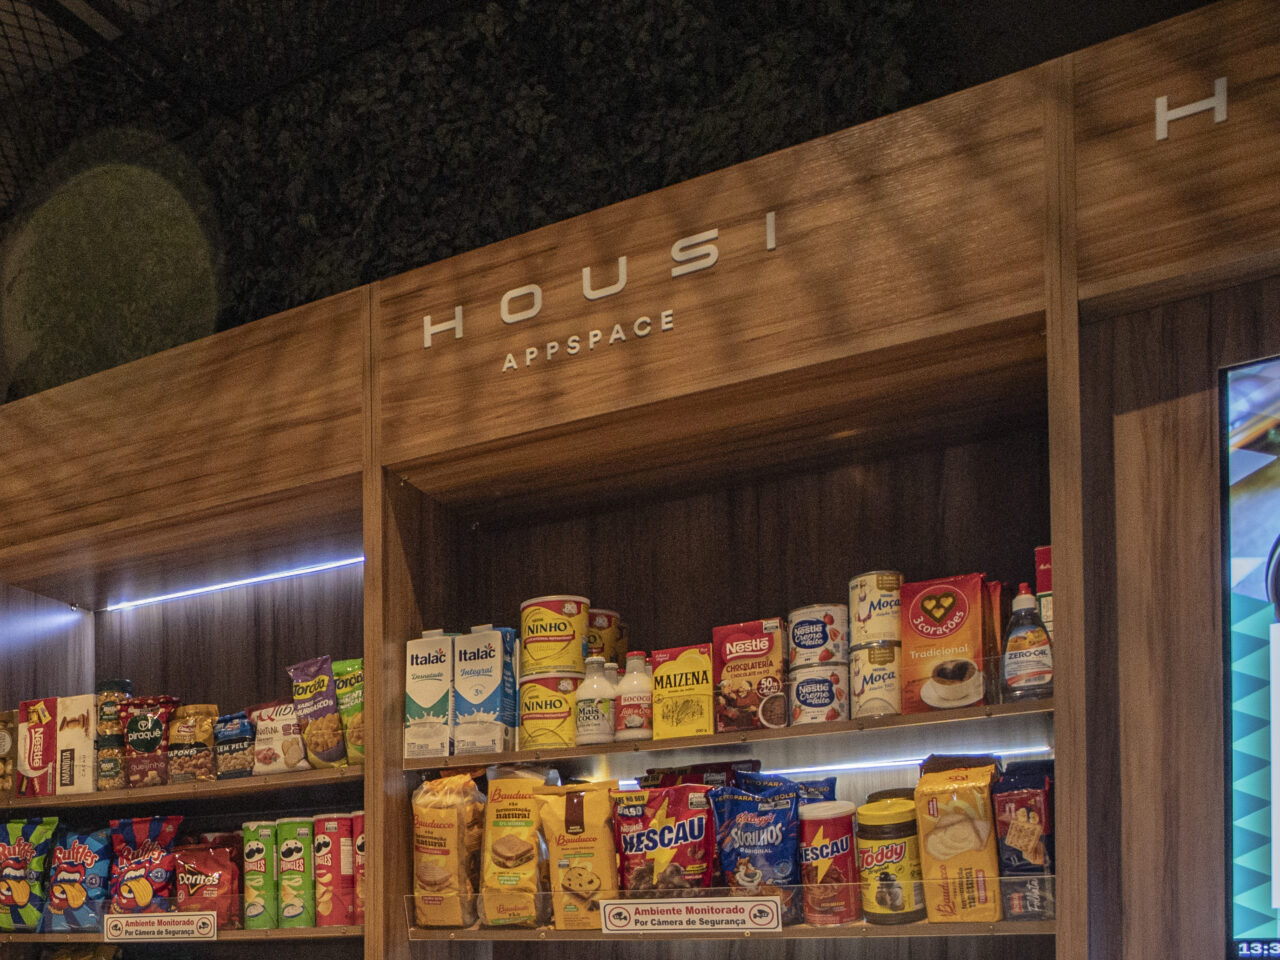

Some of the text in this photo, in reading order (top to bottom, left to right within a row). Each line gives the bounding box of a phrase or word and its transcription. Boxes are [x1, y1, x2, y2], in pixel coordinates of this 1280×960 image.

[423, 211, 777, 348] HOUSI
[502, 309, 675, 372] APPSPACE
[870, 597, 901, 613] Moça
[527, 621, 568, 637] NINHO
[793, 623, 823, 635] Nestlé
[913, 610, 965, 635] 3 corações
[794, 632, 823, 641] Creme
[725, 636, 770, 655] Nestlé
[910, 643, 969, 660] Tradicional
[410, 651, 446, 666] Italac
[458, 647, 496, 662] Italac
[460, 665, 494, 677] Integral
[654, 670, 709, 690] MAIZENA
[862, 670, 896, 689] Moça
[293, 678, 326, 697] Torcida
[799, 683, 829, 693] Nestlé
[800, 690, 830, 700] Creme
[523, 698, 563, 713] NINHO
[578, 707, 600, 715] Mais
[128, 730, 161, 742] piraquê
[33, 727, 44, 767] Nestlé
[231, 742, 249, 751] PELE
[61, 750, 71, 785] AMANDITA
[130, 760, 165, 772] queijinho
[736, 811, 776, 824] Kellogg's
[556, 835, 598, 847] Bauducco
[622, 815, 706, 855] NESCAU
[730, 822, 784, 849] SUCRILHOS
[52, 839, 99, 868] Ruffles
[118, 838, 166, 867] Ruffles
[861, 842, 906, 869] Toddy
[178, 871, 219, 885] Doritos
[935, 864, 957, 917] Bauducco
[634, 905, 745, 916] Ambiente Monitorado
[124, 918, 195, 928] Ambiente Monitorado
[634, 916, 747, 928] Por Câmera de Segurança
[124, 928, 195, 938] Por Câmera de Segurança
